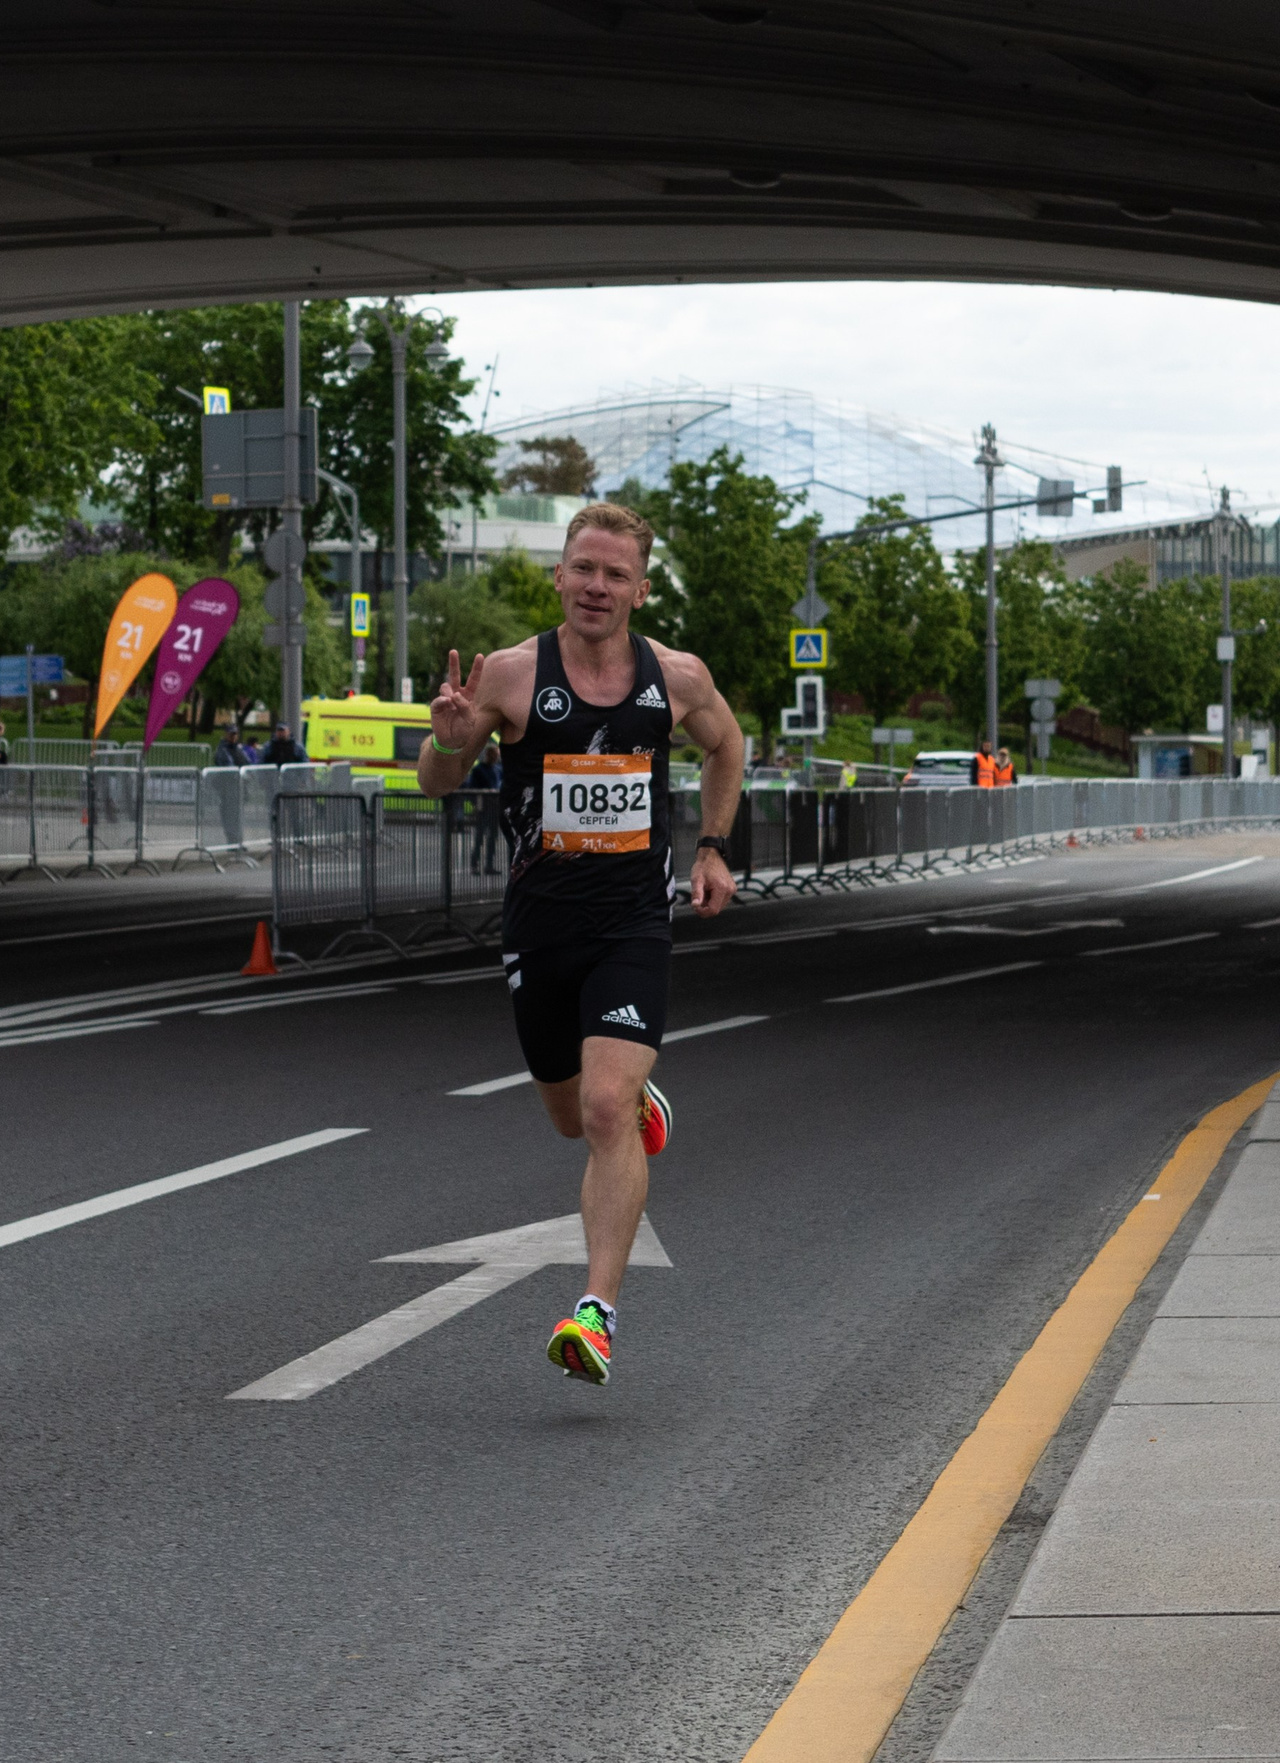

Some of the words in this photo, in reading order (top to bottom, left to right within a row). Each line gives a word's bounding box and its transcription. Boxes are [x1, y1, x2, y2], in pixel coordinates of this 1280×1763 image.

[116, 621, 144, 651] 21
[173, 624, 204, 653] 21
[635, 698, 666, 709] adidas
[351, 734, 375, 746] 103
[550, 782, 647, 813] 10832
[578, 814, 619, 825] СЕРГЕЙ
[601, 1014, 648, 1030] adidas
